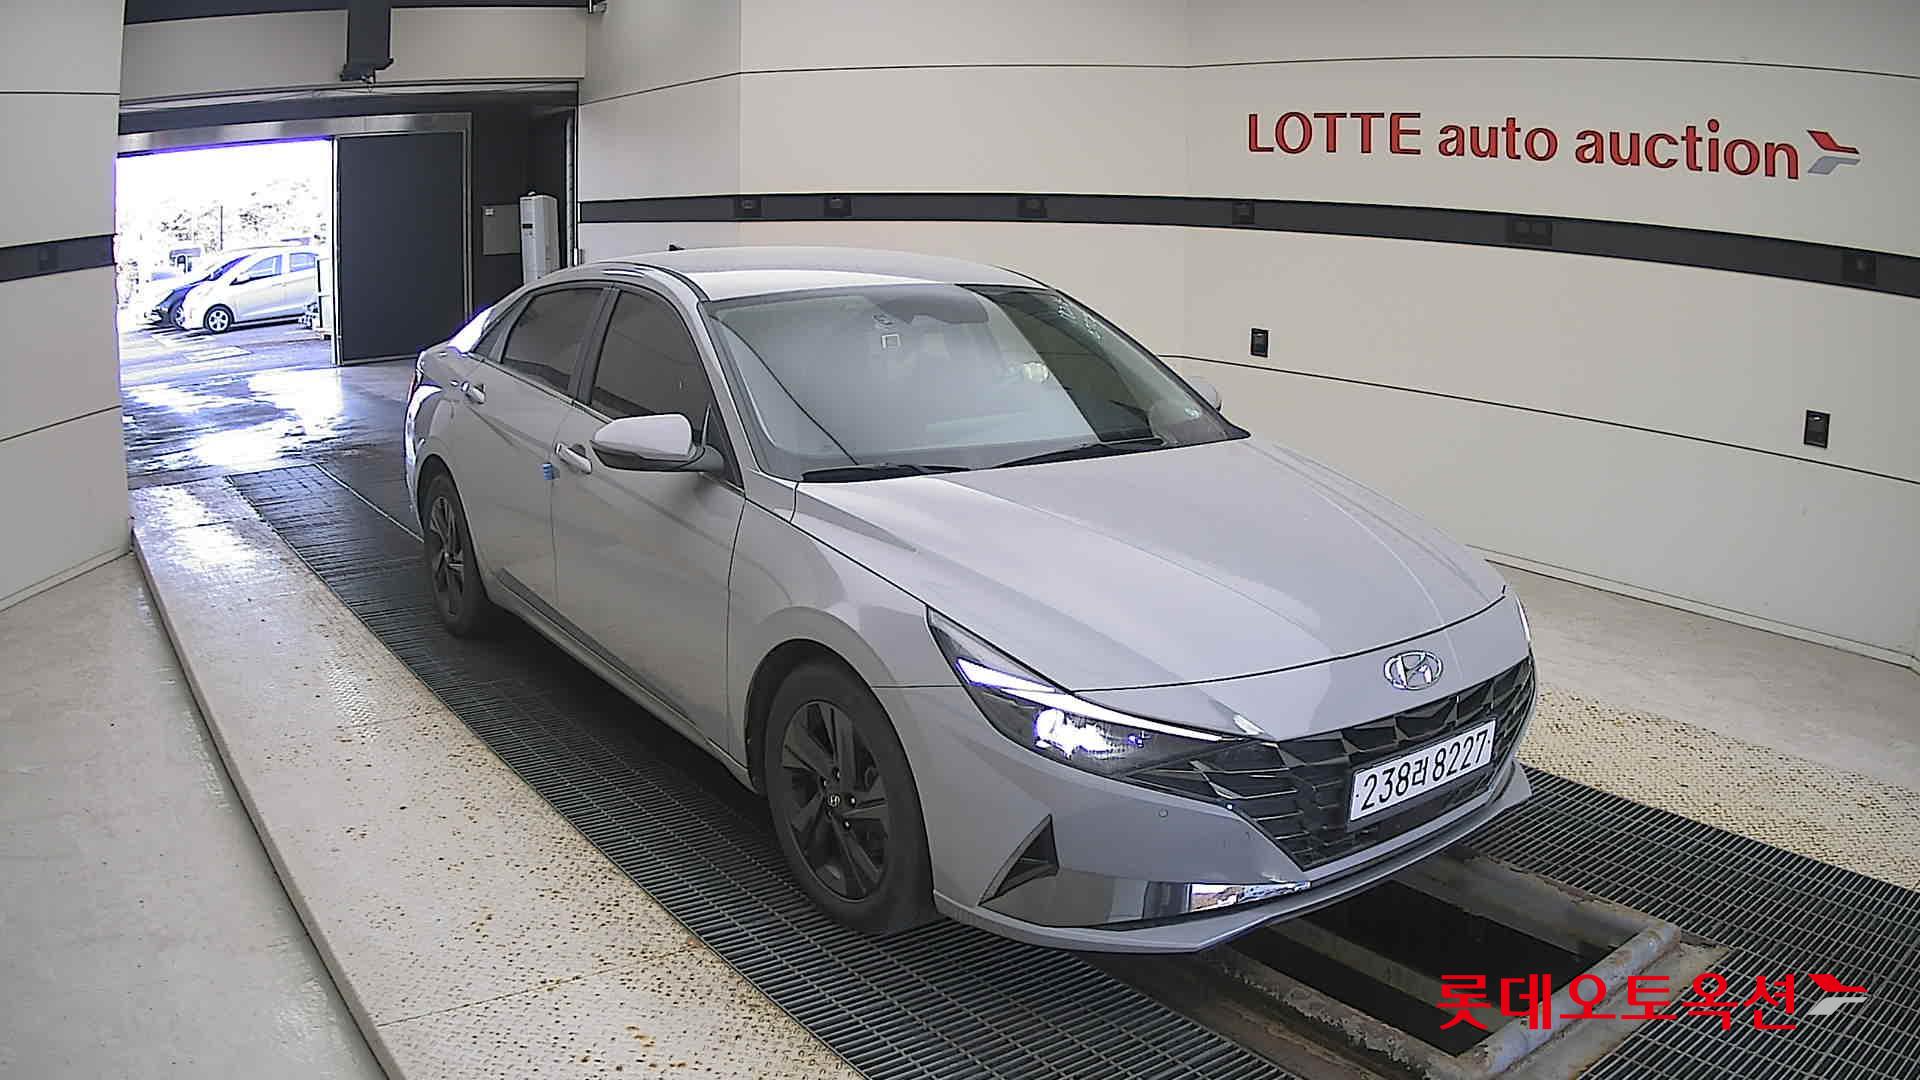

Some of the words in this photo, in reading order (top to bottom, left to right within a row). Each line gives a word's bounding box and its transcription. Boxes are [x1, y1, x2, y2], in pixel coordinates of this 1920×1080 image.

[1248, 112, 1421, 155] LOTTE
[1438, 117, 1558, 162] auto
[1575, 118, 1799, 180] auction
[1432, 729, 1488, 782] 8227
